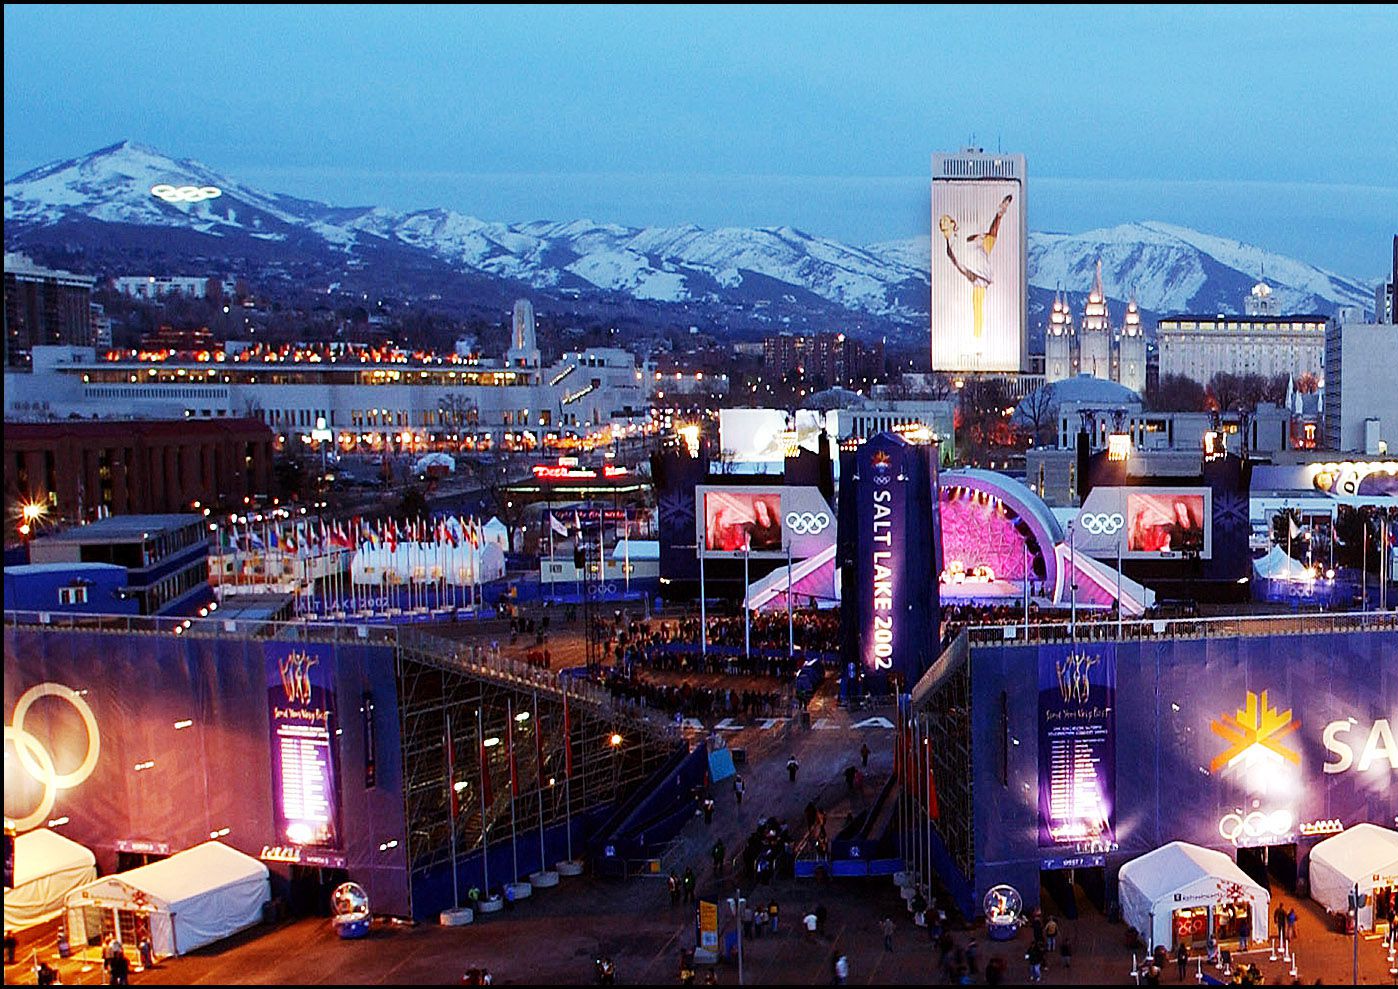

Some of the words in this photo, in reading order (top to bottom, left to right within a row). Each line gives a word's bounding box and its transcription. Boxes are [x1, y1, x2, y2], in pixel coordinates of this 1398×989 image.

[873, 490, 892, 547] SALT
[873, 551, 893, 610] LAKE
[873, 616, 893, 670] 2002
